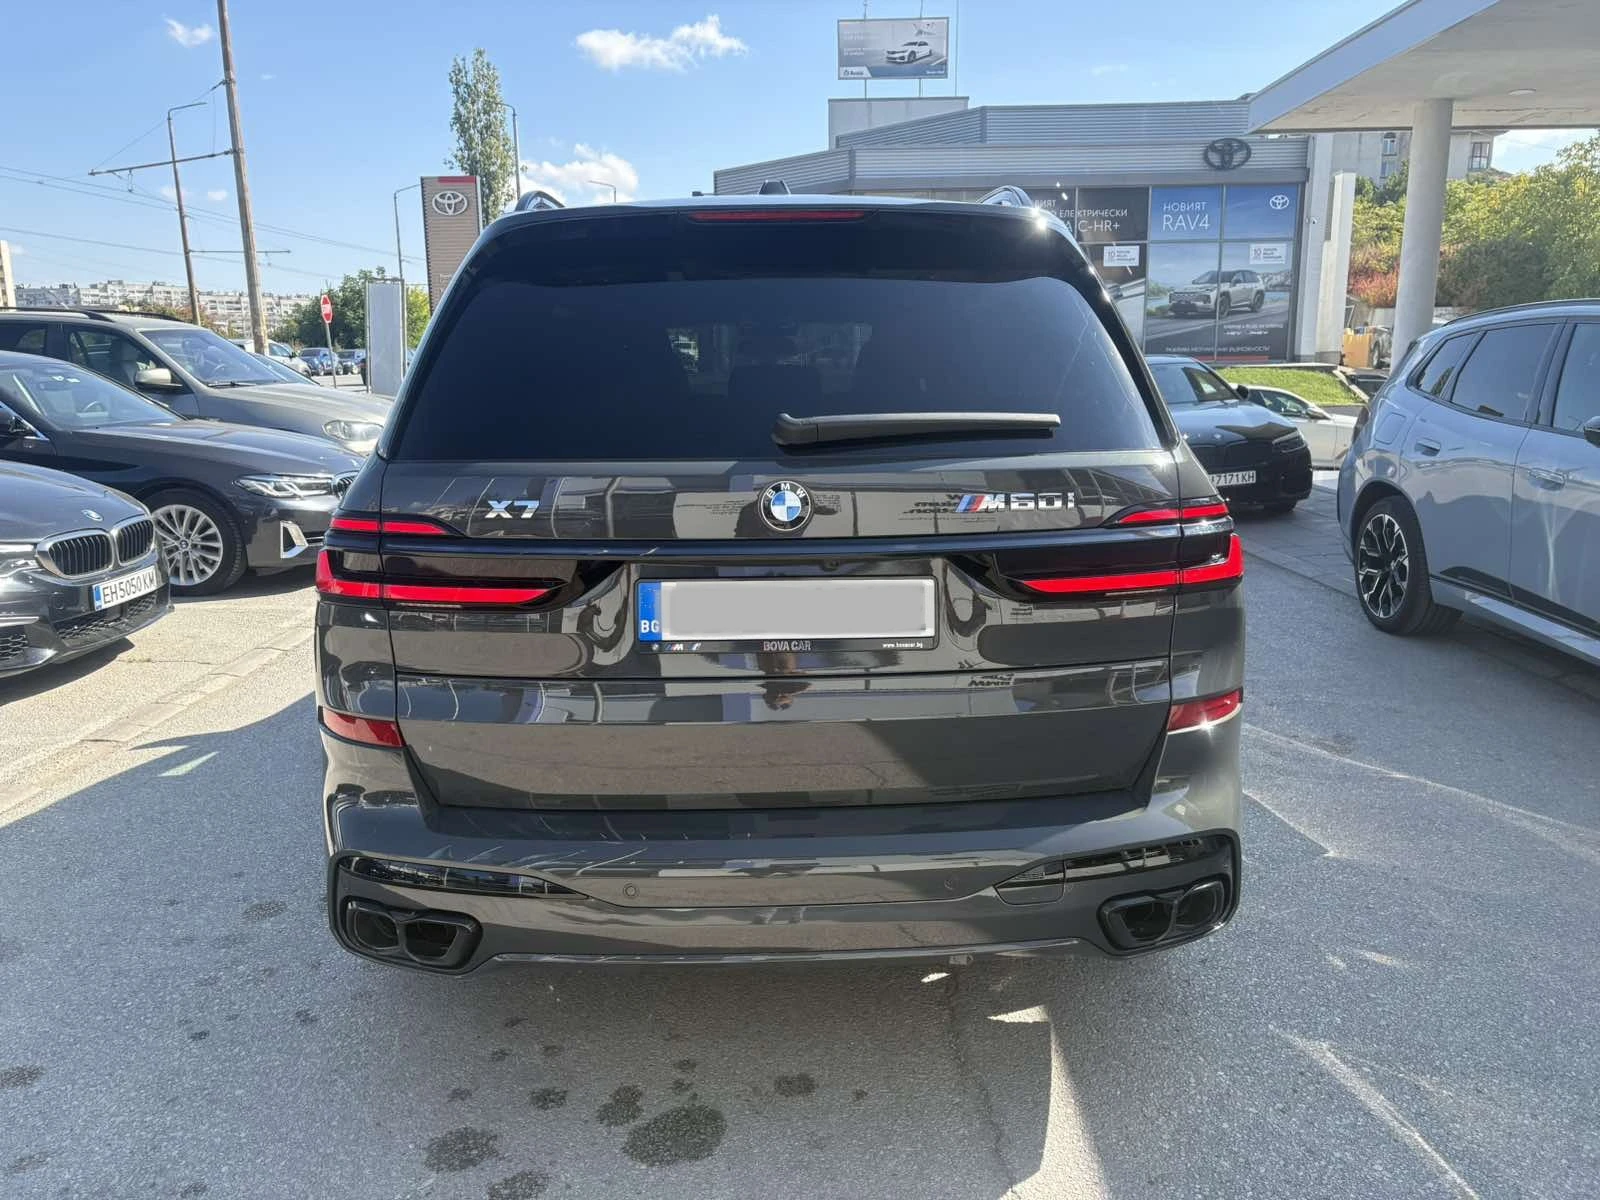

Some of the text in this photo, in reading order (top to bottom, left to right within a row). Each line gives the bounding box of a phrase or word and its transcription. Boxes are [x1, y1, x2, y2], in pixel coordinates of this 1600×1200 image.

[1059, 208, 1128, 218] ЕЛЕКТРИЧЕСКИ
[1162, 202, 1207, 212] НОВИЯТ
[1077, 220, 1120, 232] C-HR+
[1162, 214, 1210, 231] RAV4
[766, 483, 806, 498] BMW
[484, 500, 540, 518] X7
[640, 620, 660, 633] BG
[763, 640, 812, 651] BOVA CAR
